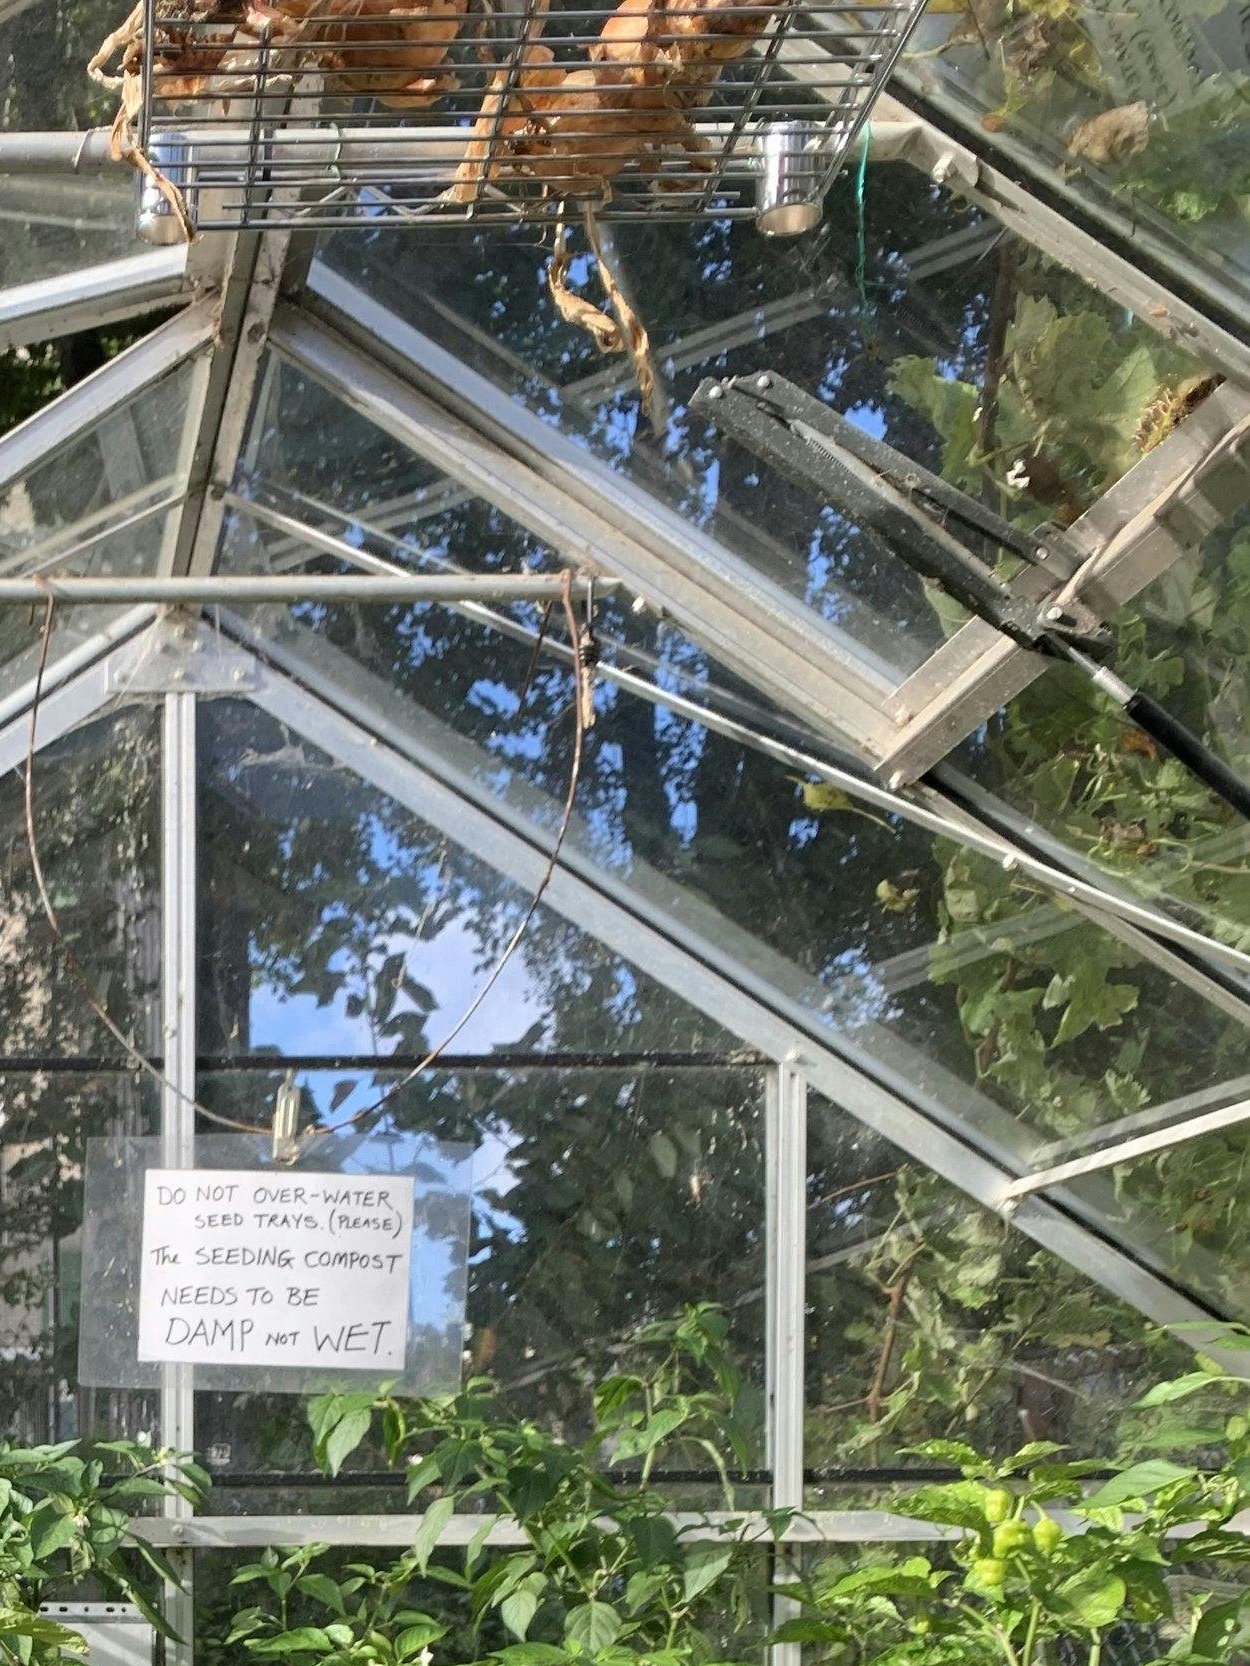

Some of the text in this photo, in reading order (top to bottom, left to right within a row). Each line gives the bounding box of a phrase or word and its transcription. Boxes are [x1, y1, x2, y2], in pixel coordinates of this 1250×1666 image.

[156, 1185, 393, 1209] DO NOT OVER-WATER
[194, 1213, 243, 1231] SEED
[328, 1209, 403, 1240] (PLEASE)
[150, 1245, 403, 1273] The SEEDING COMPOST
[160, 1286, 321, 1307] NEEDS TO BE
[164, 1317, 254, 1352] DAMP
[265, 1330, 301, 1347] NOT
